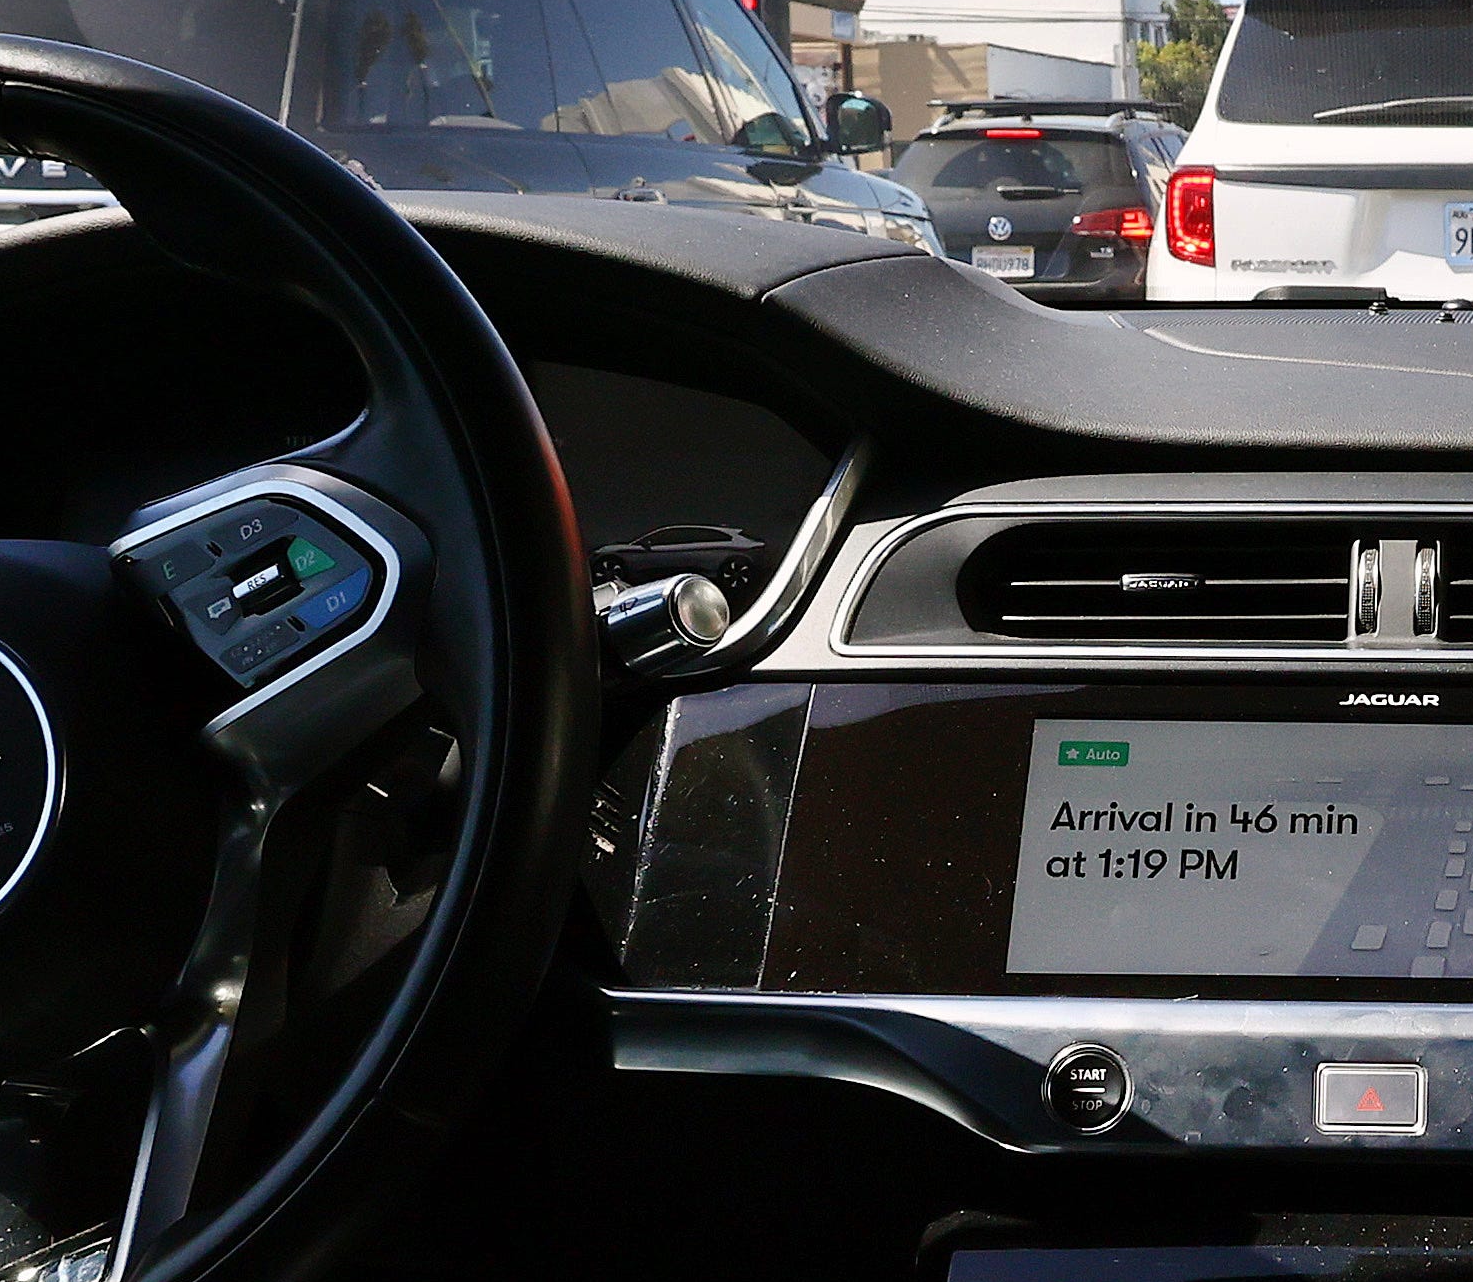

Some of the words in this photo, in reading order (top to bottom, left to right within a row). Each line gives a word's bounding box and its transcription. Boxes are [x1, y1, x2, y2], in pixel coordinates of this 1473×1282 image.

[240, 519, 263, 540] D3
[294, 551, 316, 572] D2
[247, 575, 268, 591] RES
[326, 591, 347, 612] D1
[1339, 693, 1439, 707] JAGUAR
[1086, 747, 1121, 761] Auto
[1051, 802, 1174, 834] Arrival
[1185, 804, 1218, 834] in
[1229, 804, 1278, 835] 46
[1289, 805, 1359, 835] min
[1045, 851, 1086, 879] at
[1097, 850, 1168, 879] 1:19
[1178, 850, 1239, 880] PM
[1070, 1068, 1108, 1081] START
[1071, 1099, 1103, 1112] STOP
